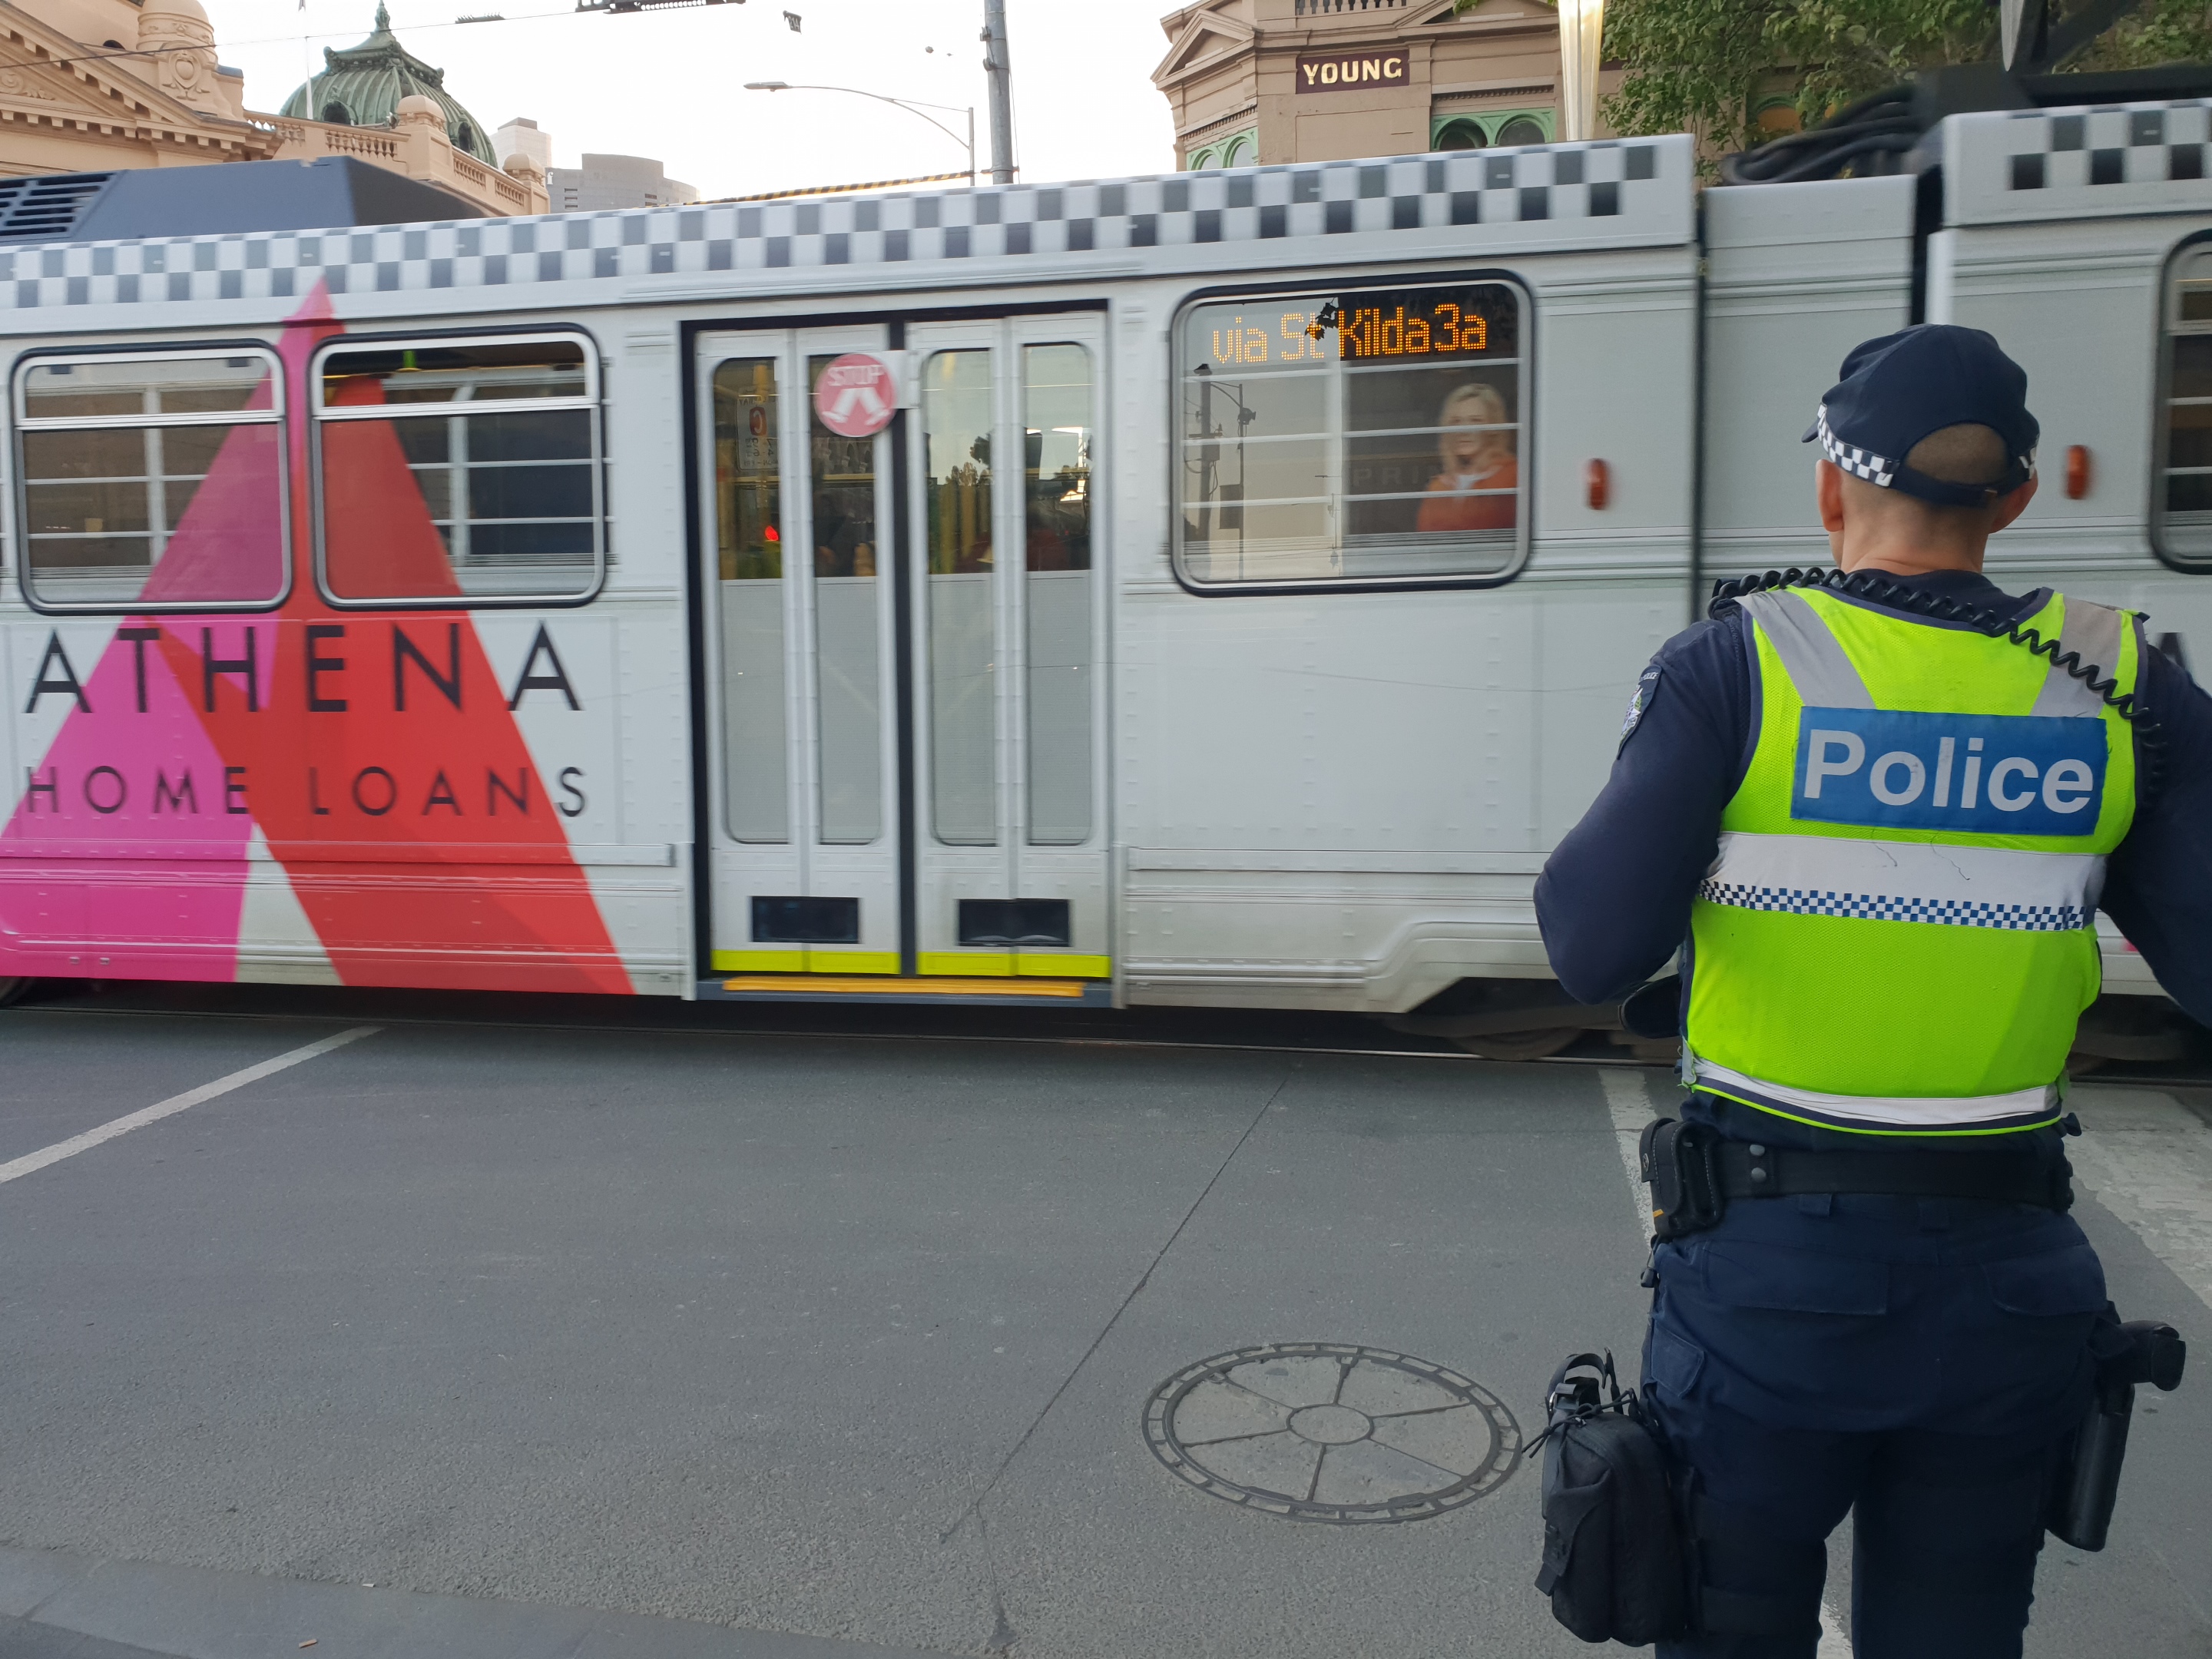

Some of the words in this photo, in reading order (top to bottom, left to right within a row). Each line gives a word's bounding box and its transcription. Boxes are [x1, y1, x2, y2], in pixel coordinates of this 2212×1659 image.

[1303, 58, 1402, 85] YOUNG
[1213, 316, 1268, 364] via
[1280, 312, 1324, 361] St
[1337, 306, 1430, 358] Kilda
[1435, 303, 1487, 352] 3a
[22, 622, 583, 714] ATHENA
[26, 766, 249, 814] HOME
[310, 766, 587, 818] LOANS
[1803, 728, 2094, 814] Police
